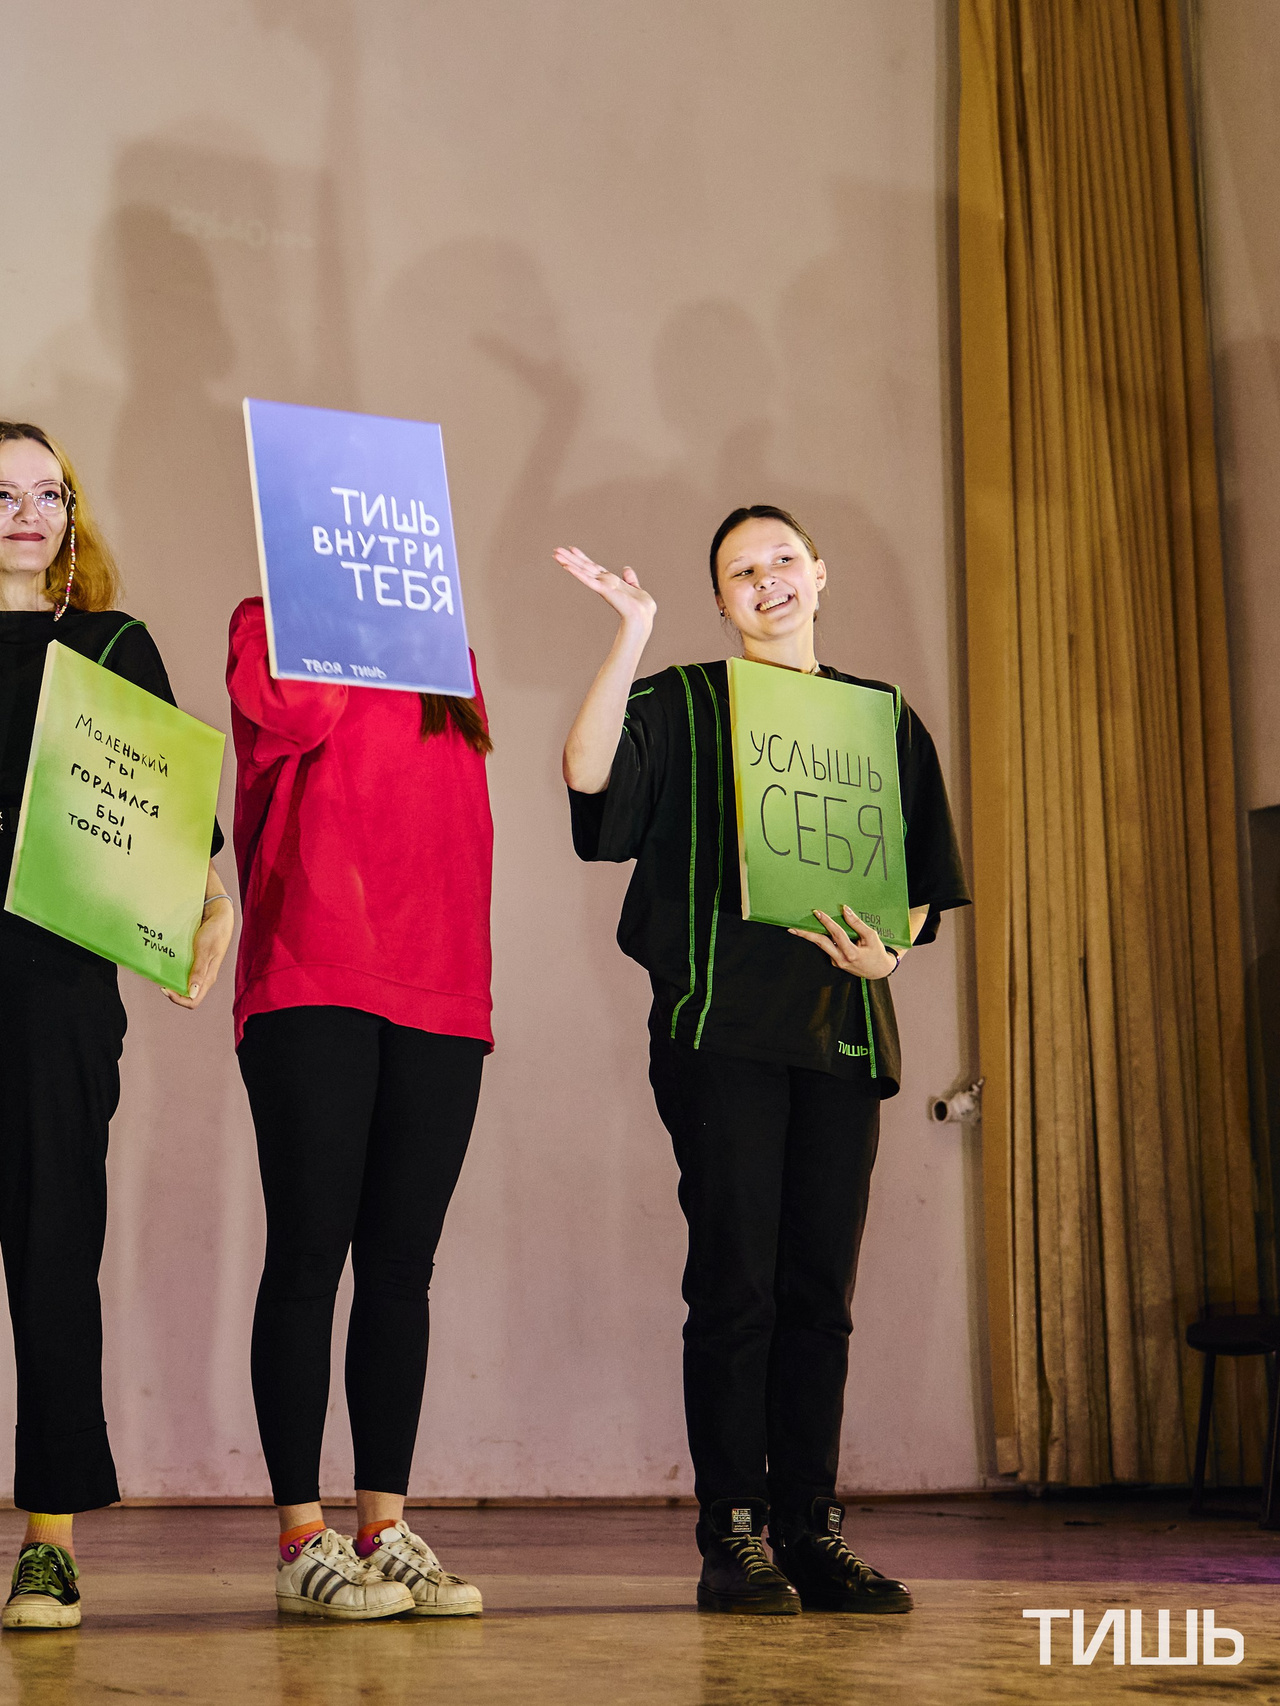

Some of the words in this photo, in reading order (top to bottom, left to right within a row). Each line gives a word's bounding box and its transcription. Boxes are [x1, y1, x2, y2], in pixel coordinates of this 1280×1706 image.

[330, 486, 440, 537] ТИШЬ
[312, 526, 444, 572] ВНУТРИ
[340, 561, 454, 616] ТЕБЯ
[302, 658, 342, 675] ТВОЯ
[349, 664, 387, 679] ТИШЬ
[105, 756, 134, 780] ТЫ
[749, 730, 883, 794] УСЛЫШЬ
[71, 763, 160, 819] ГОРДИЛСЯ
[68, 812, 132, 855] ТОБОЙ!
[96, 804, 125, 827] БЫ
[760, 784, 888, 881] СЕБЯ
[859, 911, 881, 925] ТВОЯ
[838, 1040, 869, 1057] ТИШЬ
